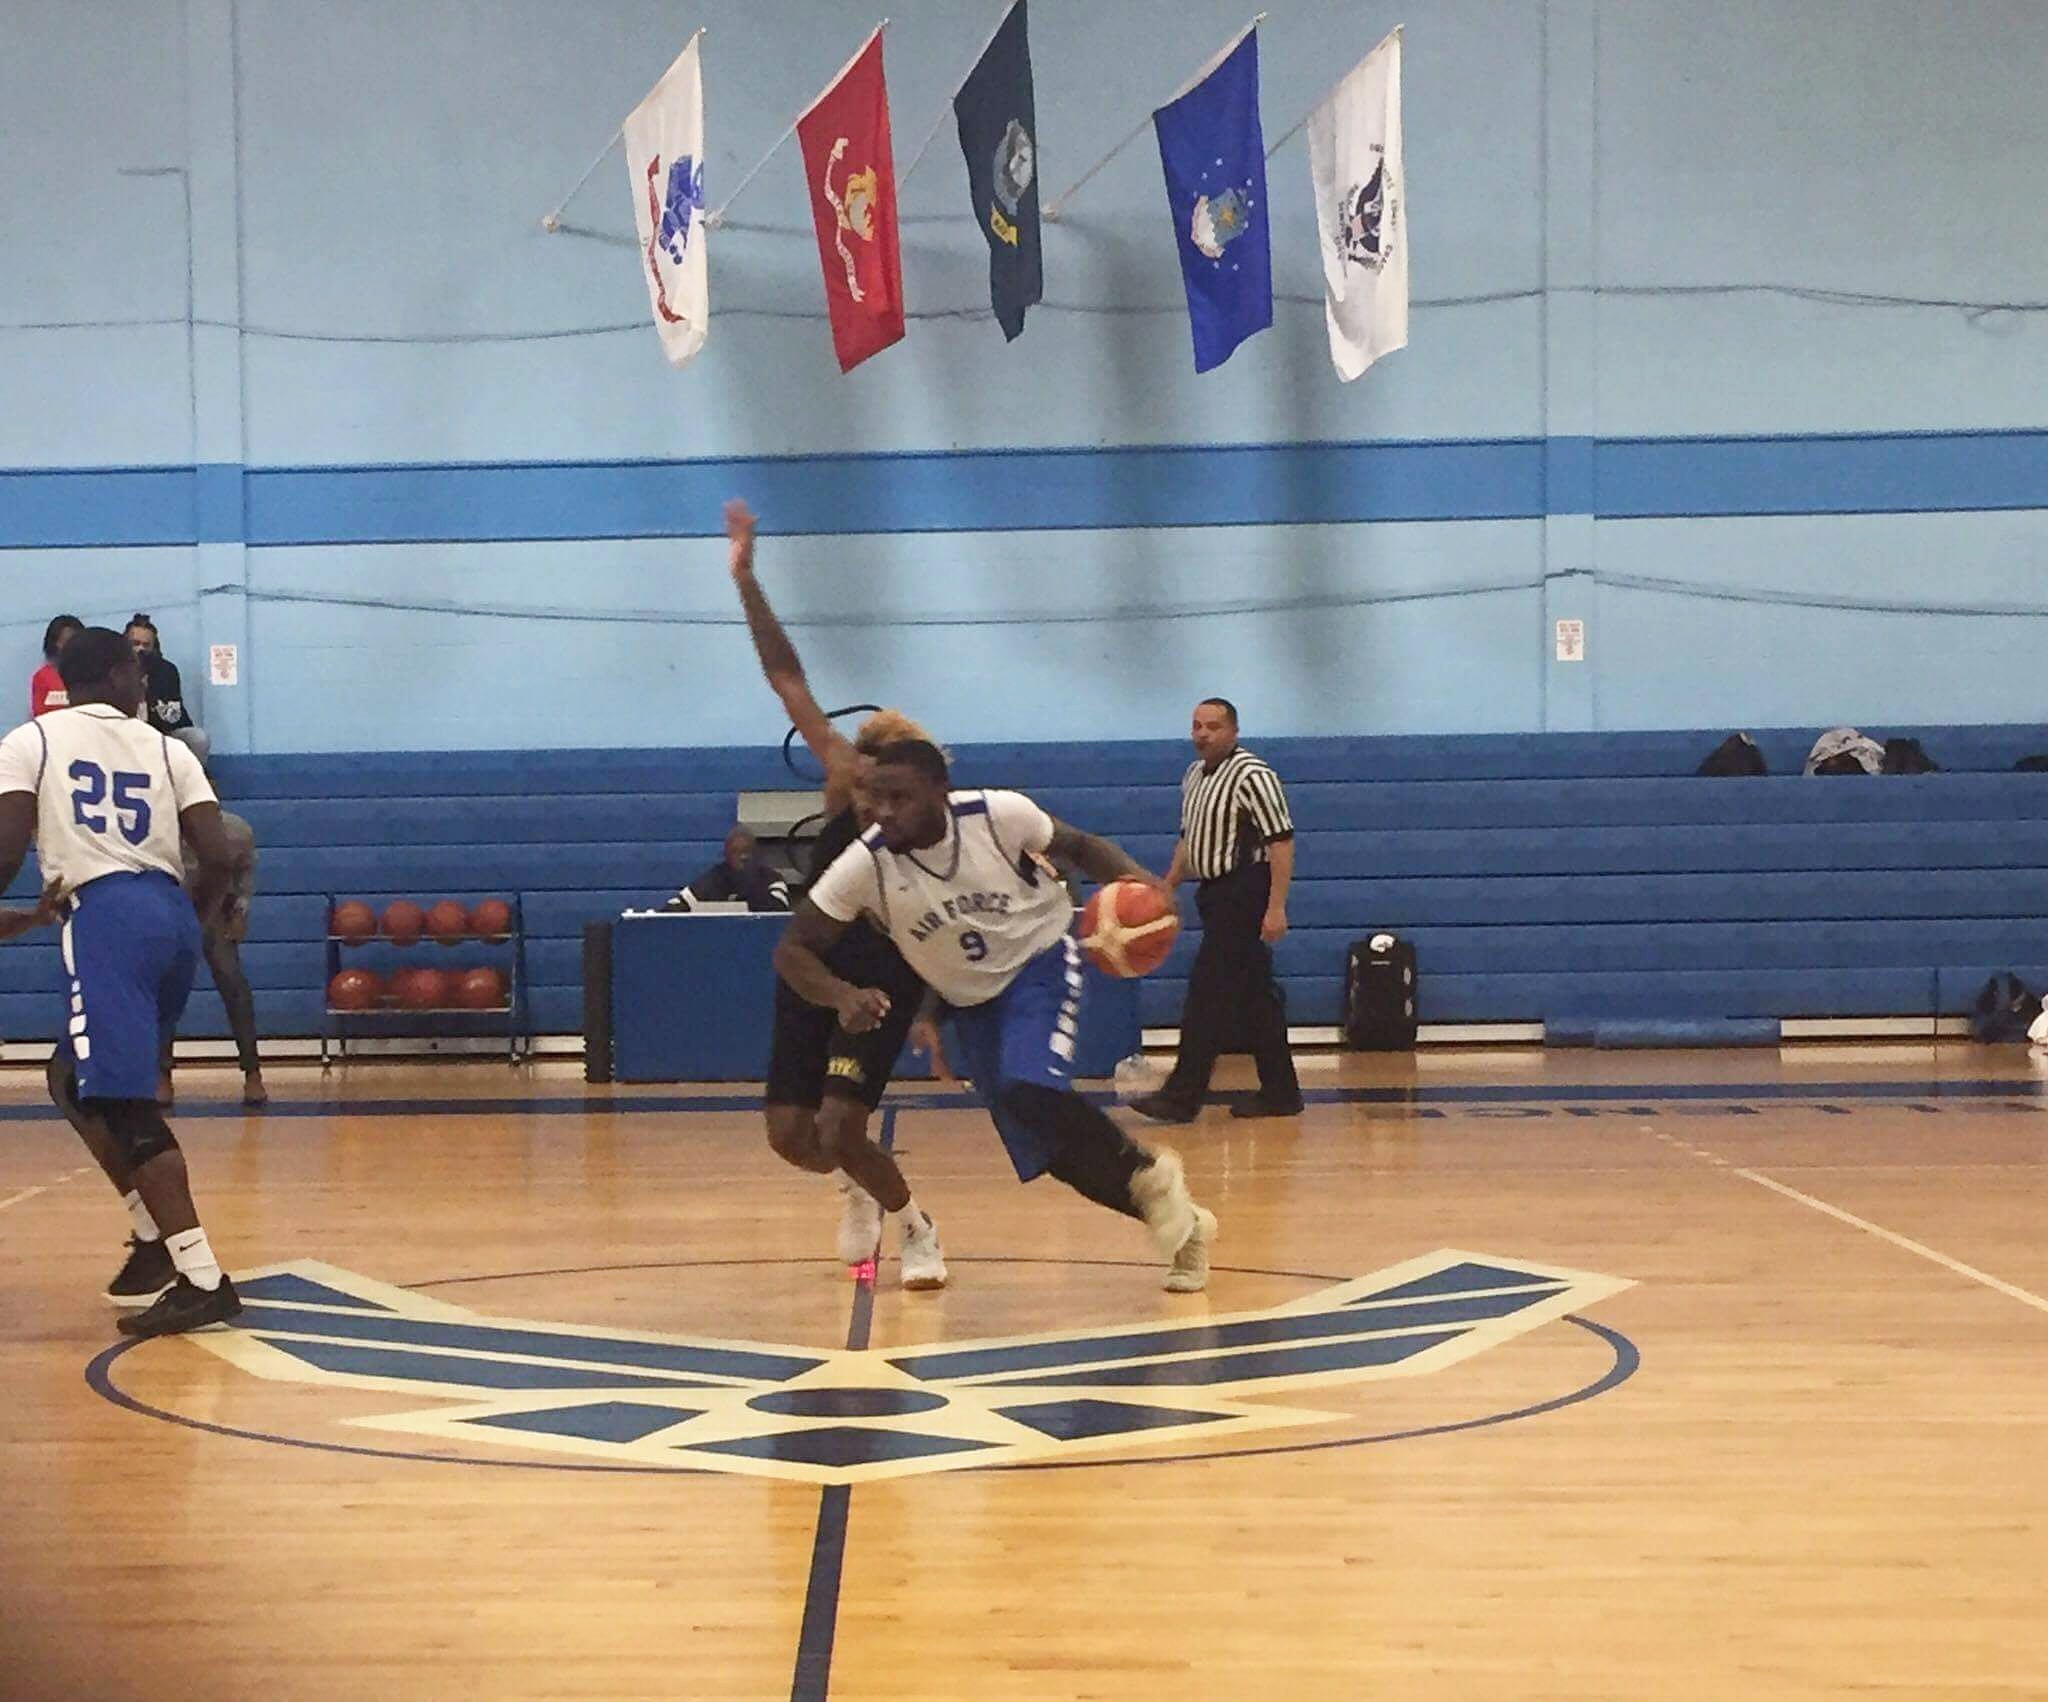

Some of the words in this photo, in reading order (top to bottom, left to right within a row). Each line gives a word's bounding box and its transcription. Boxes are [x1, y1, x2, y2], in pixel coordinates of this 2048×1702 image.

[69, 759, 151, 846] 25
[909, 911, 943, 941] AIR
[942, 892, 1010, 919] FORCE
[960, 930, 987, 961] 9
